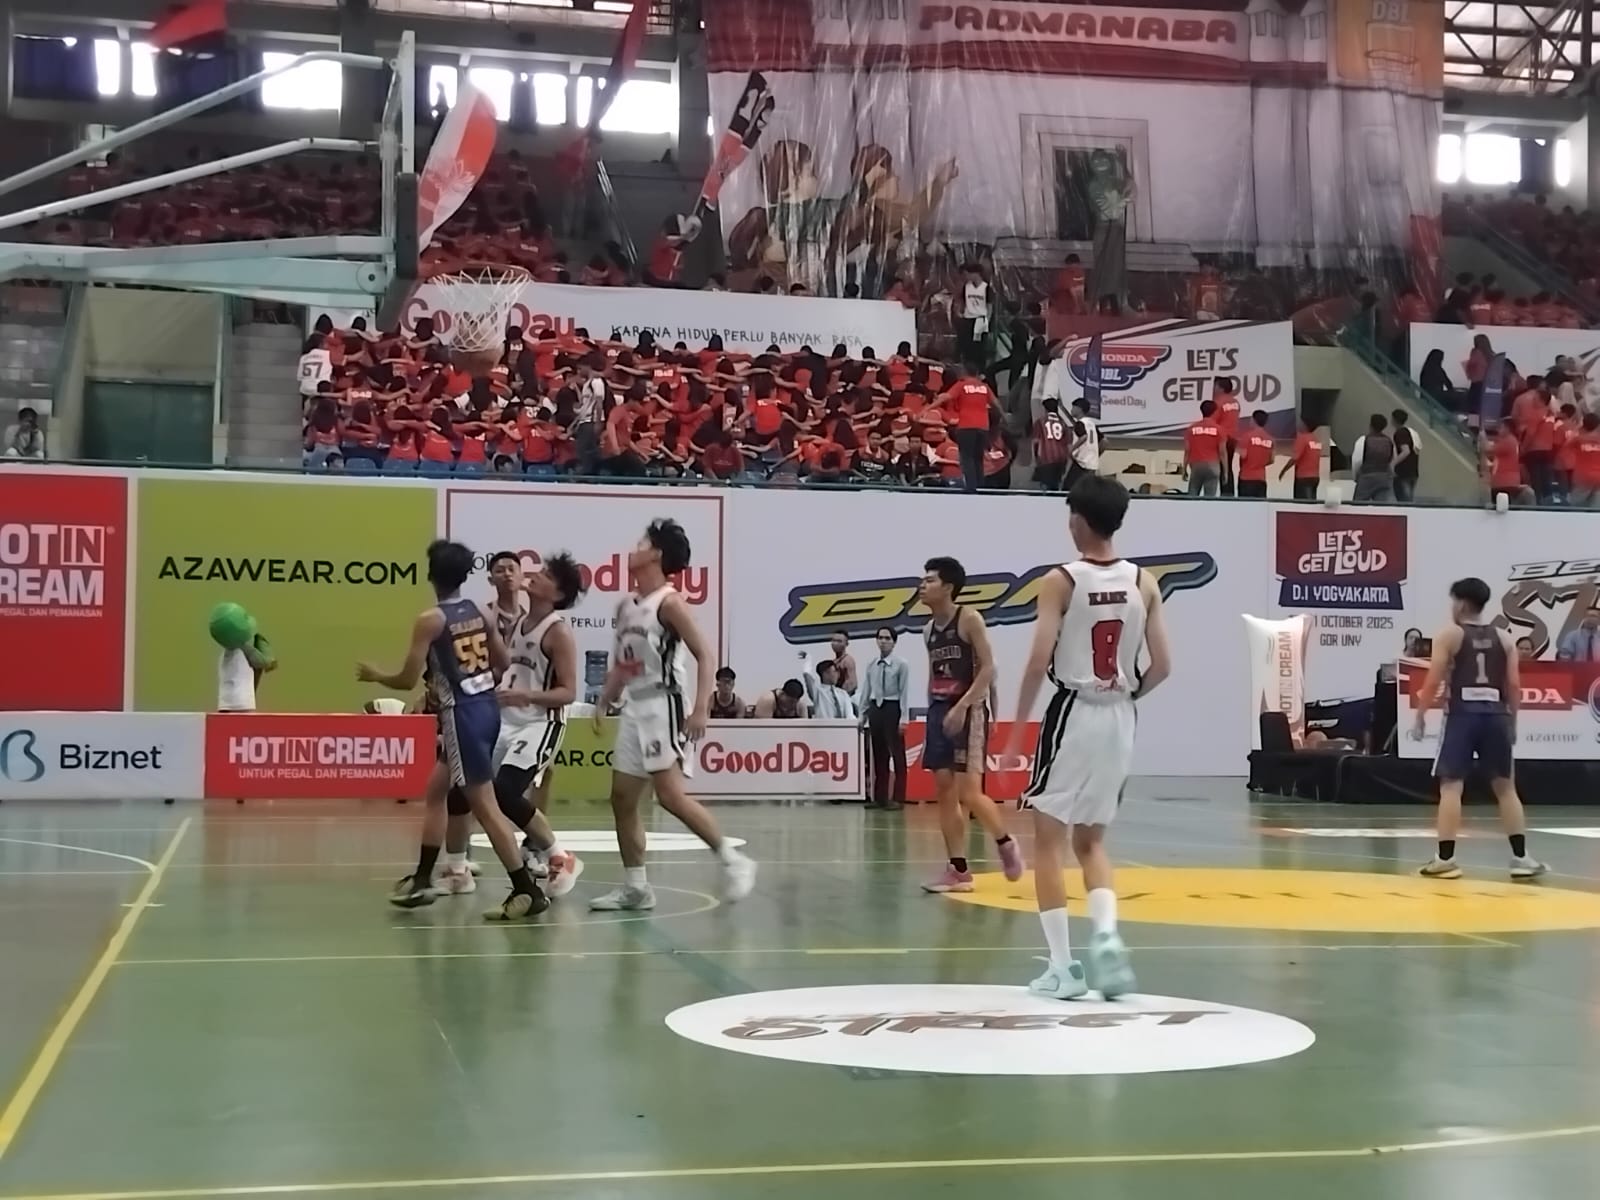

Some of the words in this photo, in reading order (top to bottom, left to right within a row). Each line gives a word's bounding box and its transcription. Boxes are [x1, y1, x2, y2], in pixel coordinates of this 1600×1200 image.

[918, 6, 1239, 43] PADMANABA
[724, 329, 764, 342] PERLU
[770, 331, 823, 345] BANYAK
[1187, 348, 1239, 371] LET'S
[1163, 377, 1212, 402] GET
[1213, 373, 1281, 403] OUD
[1045, 421, 1062, 440] 18
[0, 524, 58, 565] OT
[1318, 530, 1363, 552] LET'S
[158, 556, 417, 585] AZAWEAR.COM
[1298, 553, 1335, 574] GET
[1334, 549, 1387, 575] LOUD
[0, 568, 104, 606] REAM
[1313, 585, 1390, 603] YOGYAKARTA
[571, 617, 605, 628] PERLU
[1321, 615, 1362, 628] OCTOBER
[1366, 616, 1393, 629] 2025
[1091, 619, 1124, 681] 8
[1320, 634, 1338, 646] GOR
[1341, 634, 1362, 646] UNY
[453, 632, 489, 676] 55
[1278, 631, 1293, 678] CREAM
[1476, 652, 1489, 684] 1
[60, 743, 162, 770] Biznet
[228, 736, 285, 764] HOT
[286, 737, 313, 764] IN
[317, 737, 415, 765] CREAM
[513, 740, 529, 755] 7
[239, 768, 274, 778] UNTUK
[277, 768, 313, 779] PEGAL
[315, 768, 338, 778] DAN
[340, 768, 405, 779] PEMANASAN
[700, 741, 782, 774] Good
[788, 741, 849, 782] Day
